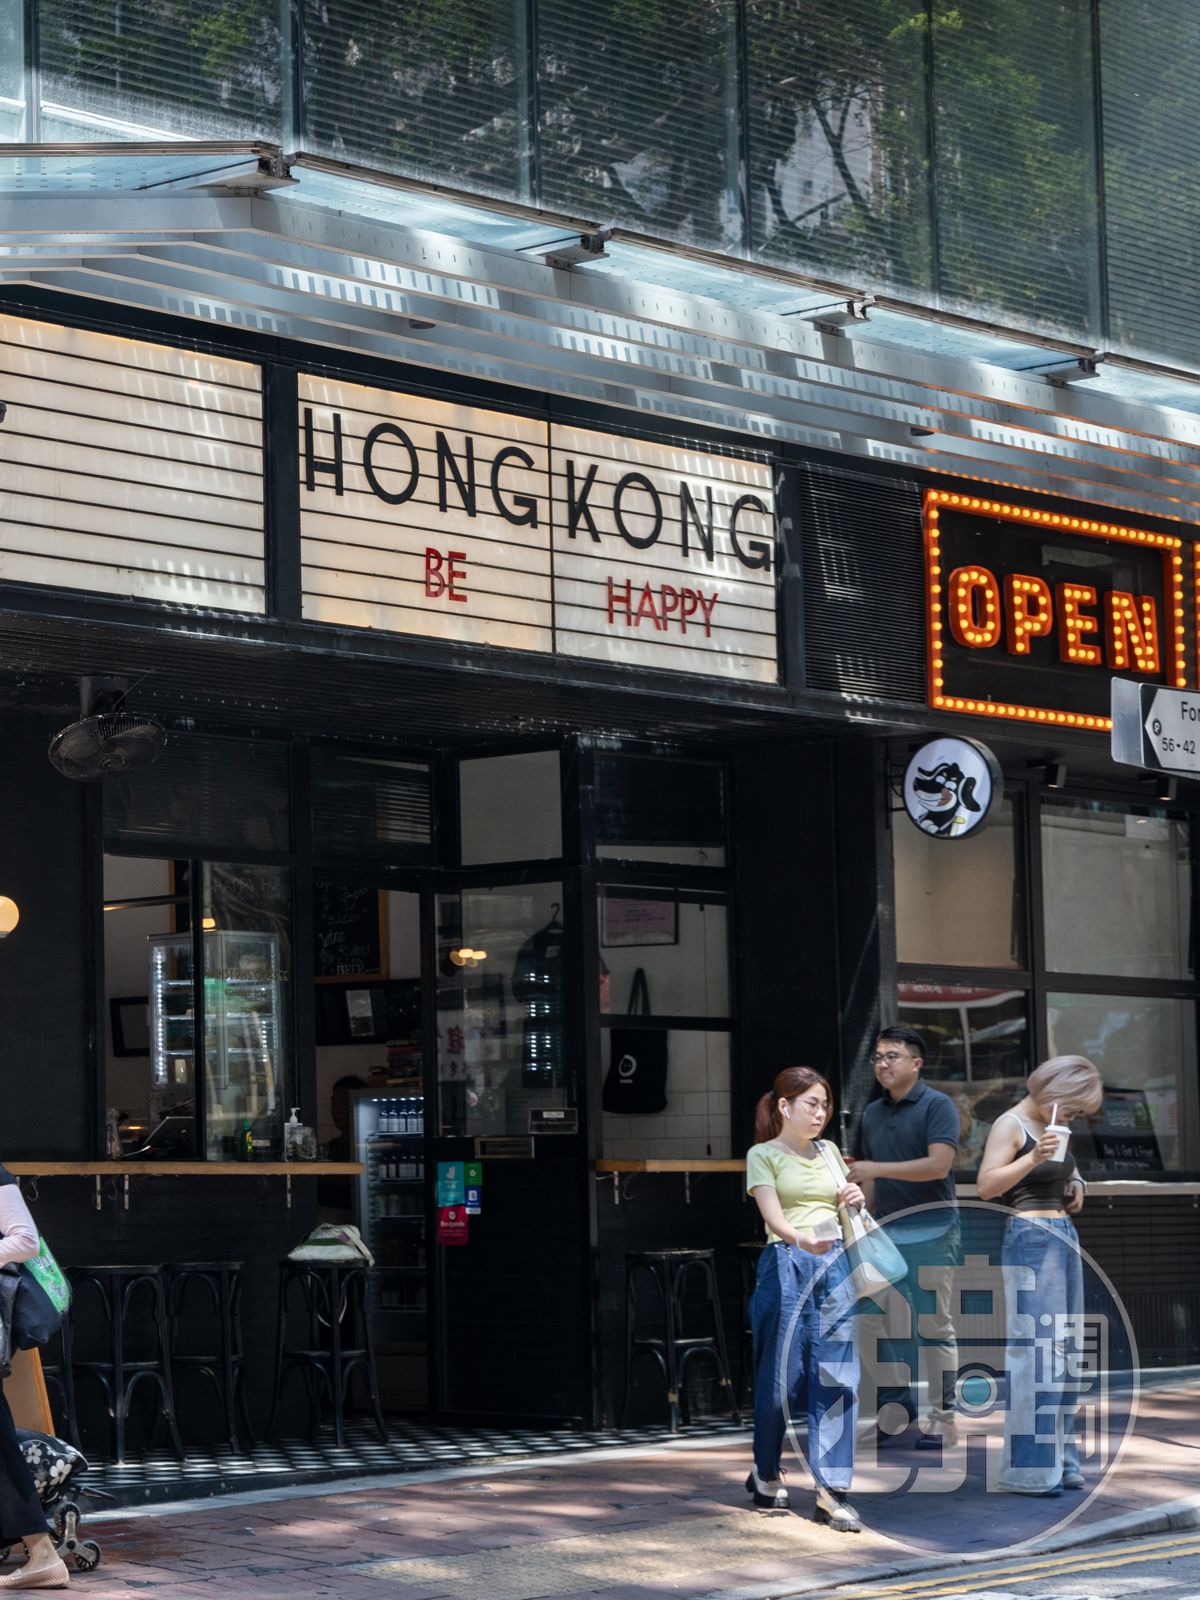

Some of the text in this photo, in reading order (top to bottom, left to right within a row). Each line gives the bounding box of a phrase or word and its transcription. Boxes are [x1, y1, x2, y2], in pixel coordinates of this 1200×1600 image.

[304, 407, 772, 571] HONG KONG
[425, 547, 718, 638] BE HAPPY
[949, 565, 1160, 674] OPEN
[1181, 701, 1200, 721] Fo
